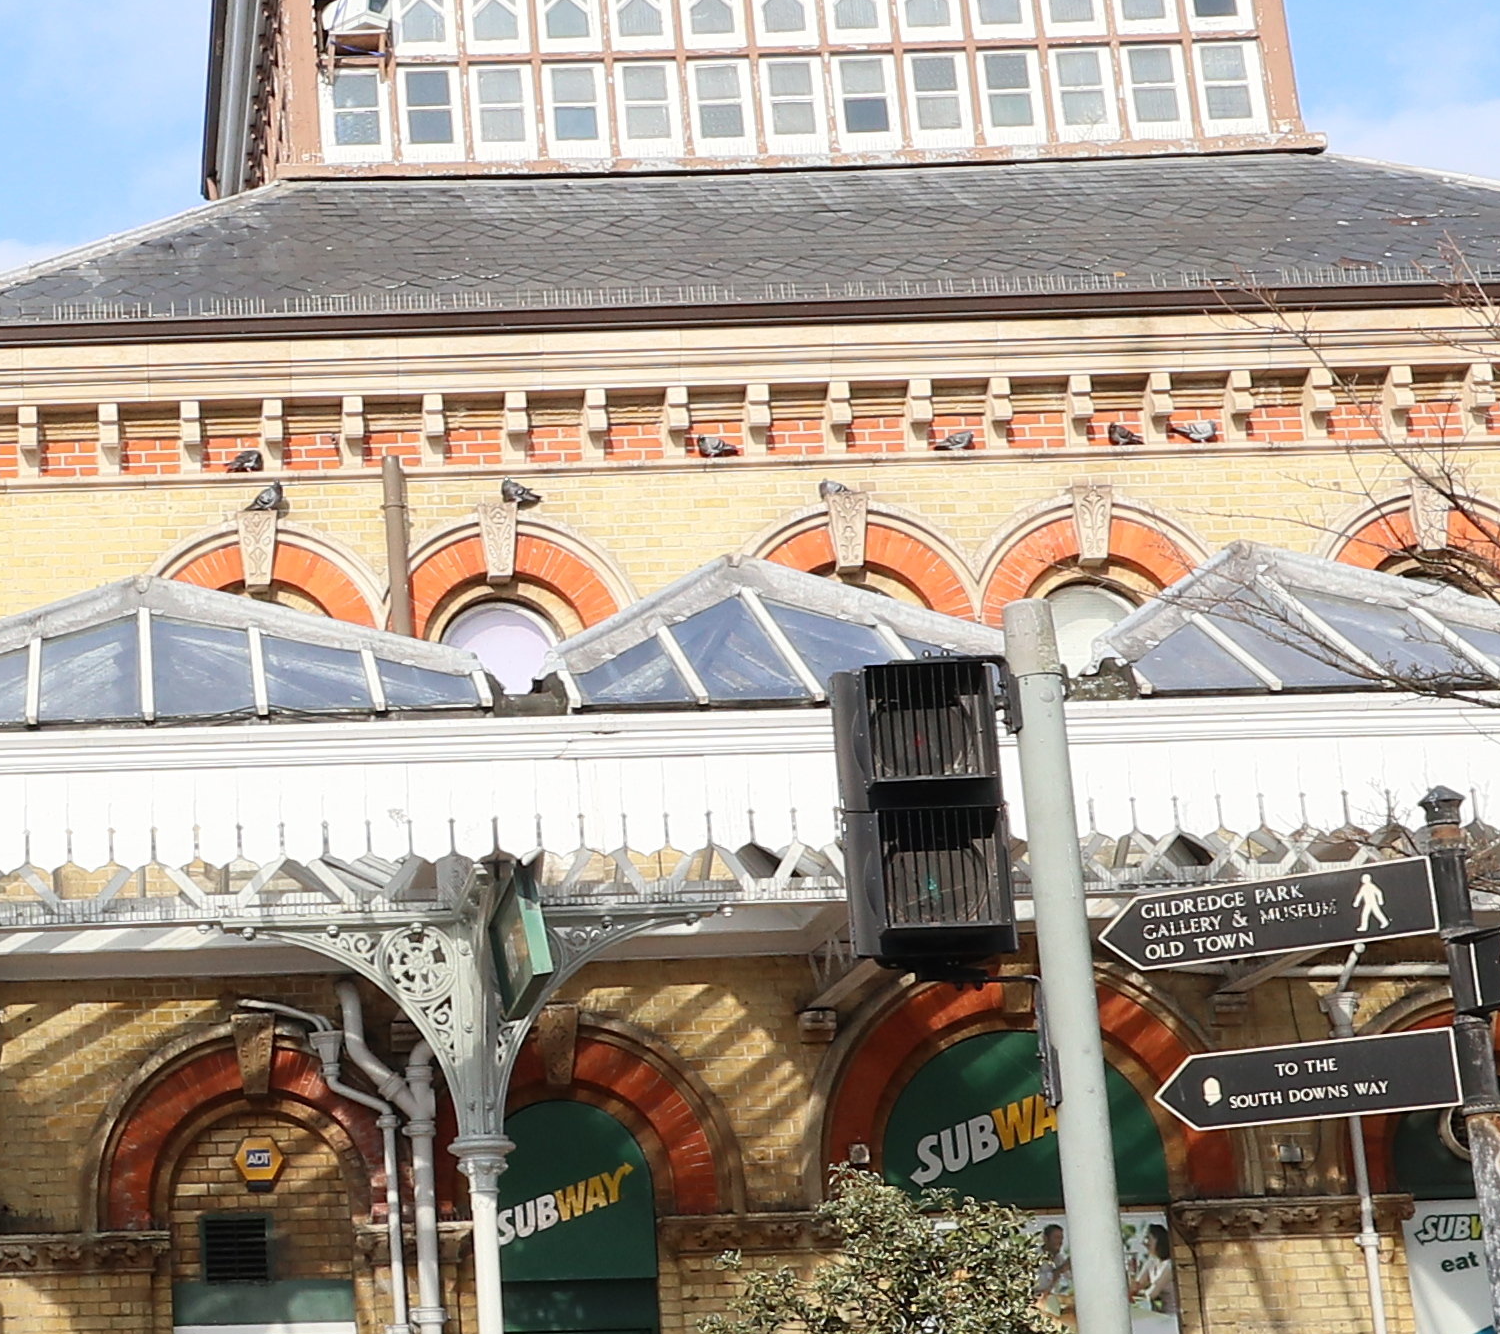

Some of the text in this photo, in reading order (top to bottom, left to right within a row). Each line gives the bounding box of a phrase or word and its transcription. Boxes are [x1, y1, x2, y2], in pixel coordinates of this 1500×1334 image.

[1141, 883, 1305, 919] GILDREDGE PARK
[1143, 915, 1223, 940] GALLERY
[1231, 909, 1248, 929] &
[1145, 932, 1255, 961] OLD TOWN
[1274, 1058, 1338, 1077] TO THE
[1229, 1080, 1390, 1109] SOUTH DOWNS WAY
[909, 1094, 1059, 1187] SUBWA
[246, 1152, 271, 1165] ADT
[497, 1162, 634, 1246] SUBWAY
[1441, 1252, 1480, 1273] eat
